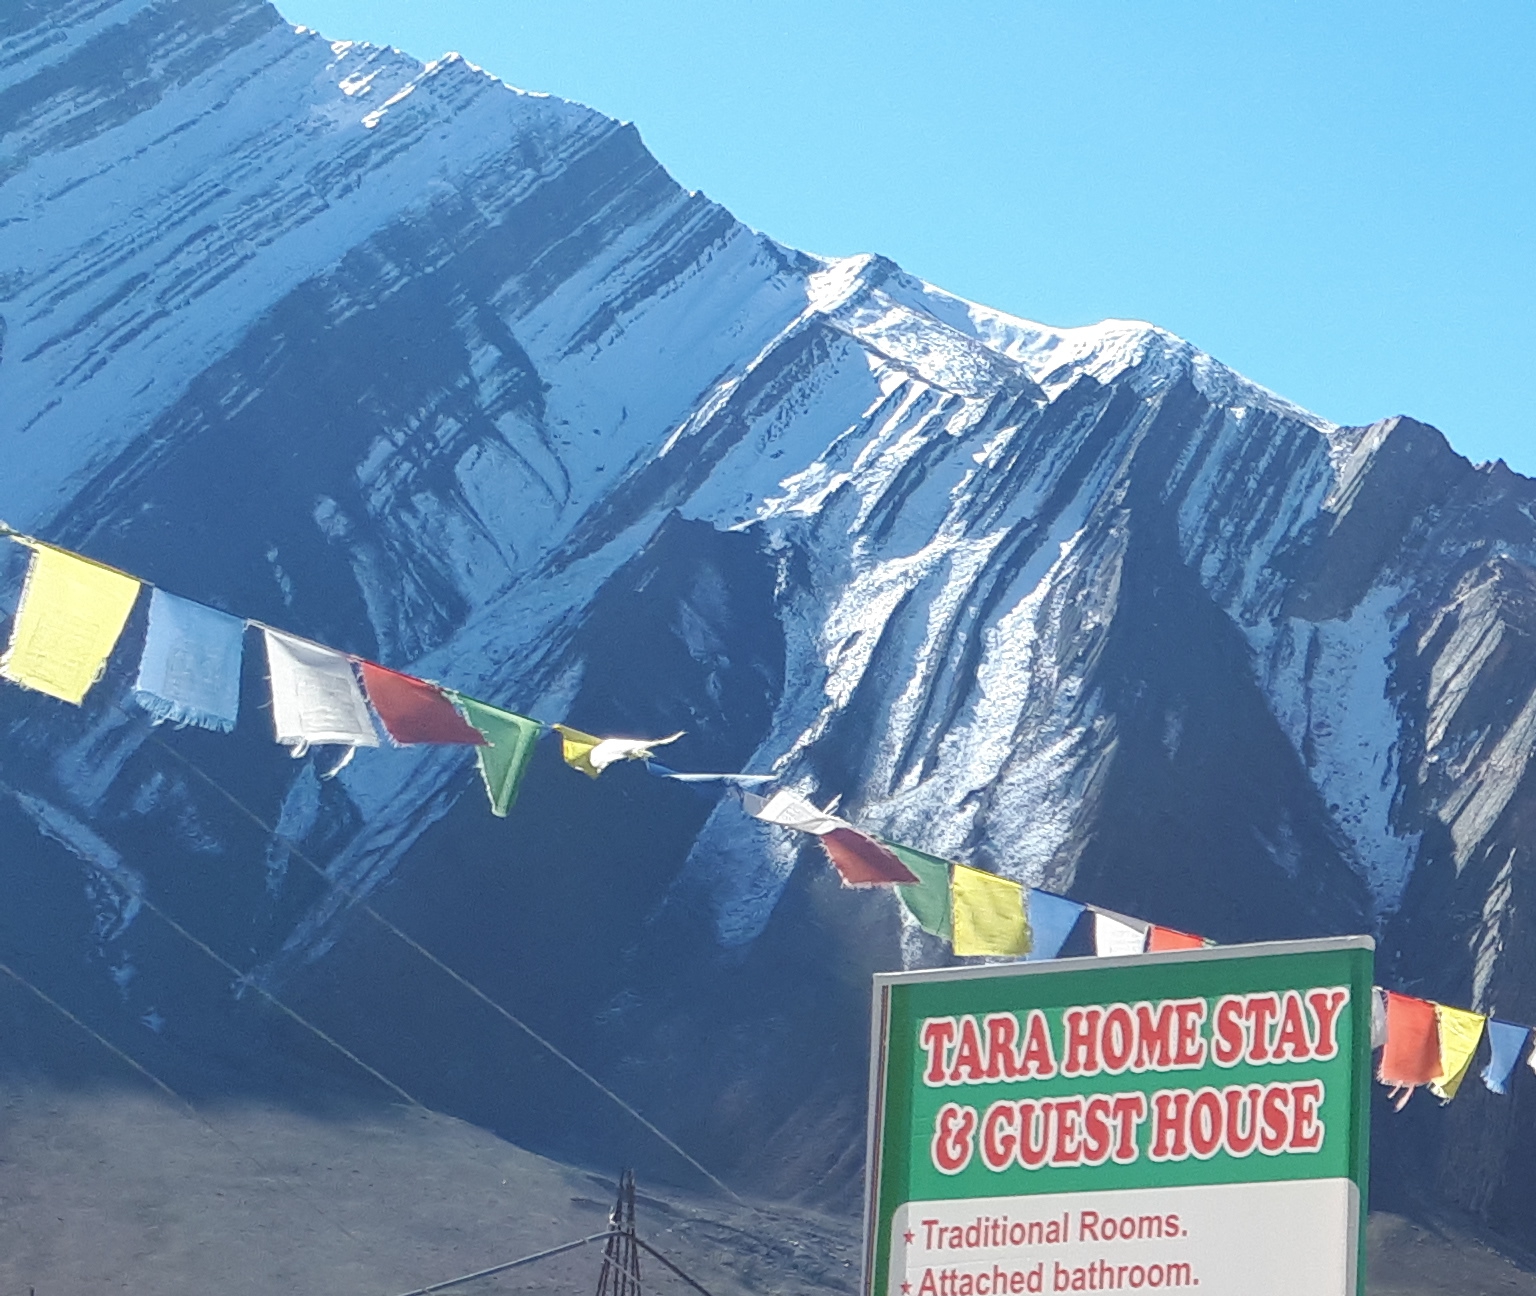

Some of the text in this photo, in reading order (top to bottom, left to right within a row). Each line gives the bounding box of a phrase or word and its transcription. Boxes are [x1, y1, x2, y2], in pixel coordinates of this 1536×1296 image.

[920, 986, 1350, 1087] TARA HOME STAY
[931, 1079, 1325, 1175] & GUEST HOUSE
[922, 1210, 1189, 1250] Traditional Rooms.
[1053, 1259, 1200, 1292] bathroom.
